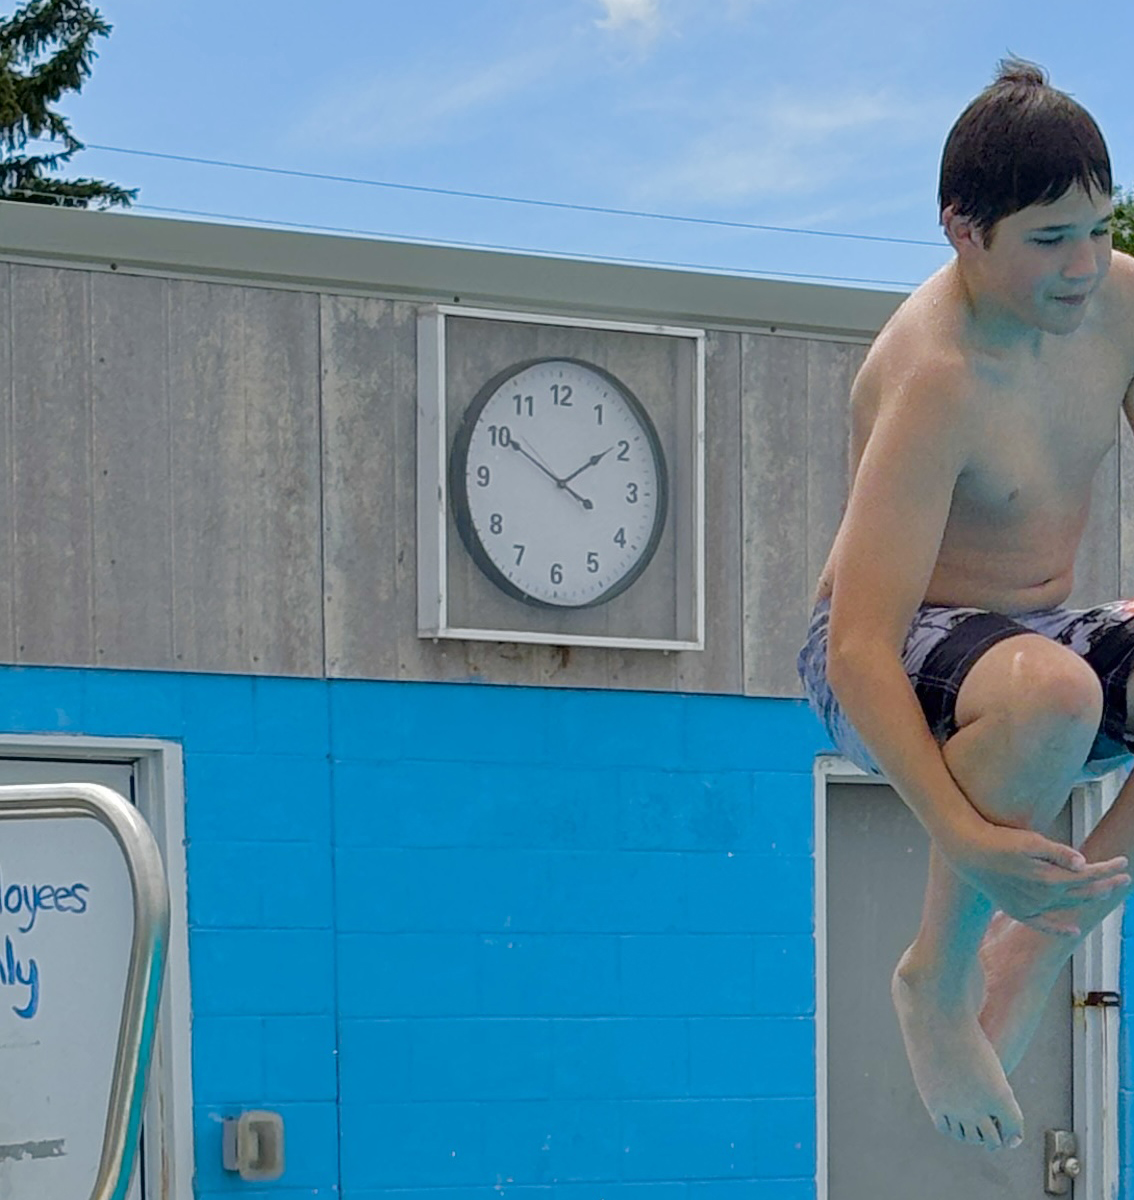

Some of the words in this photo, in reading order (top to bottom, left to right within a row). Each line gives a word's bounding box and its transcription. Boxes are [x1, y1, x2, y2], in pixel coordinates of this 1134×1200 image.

[512, 394, 534, 417] 11
[550, 384, 573, 407] 12
[593, 404, 603, 425] 1
[487, 425, 511, 447] 10
[616, 440, 630, 461] 2
[476, 466, 490, 487] 9
[625, 482, 638, 504] 3
[489, 513, 503, 534] 8
[613, 527, 626, 549] 4
[512, 544, 525, 566] 7
[586, 552, 599, 573] 5
[550, 563, 563, 585] 6
[0, 883, 90, 933] oyees
